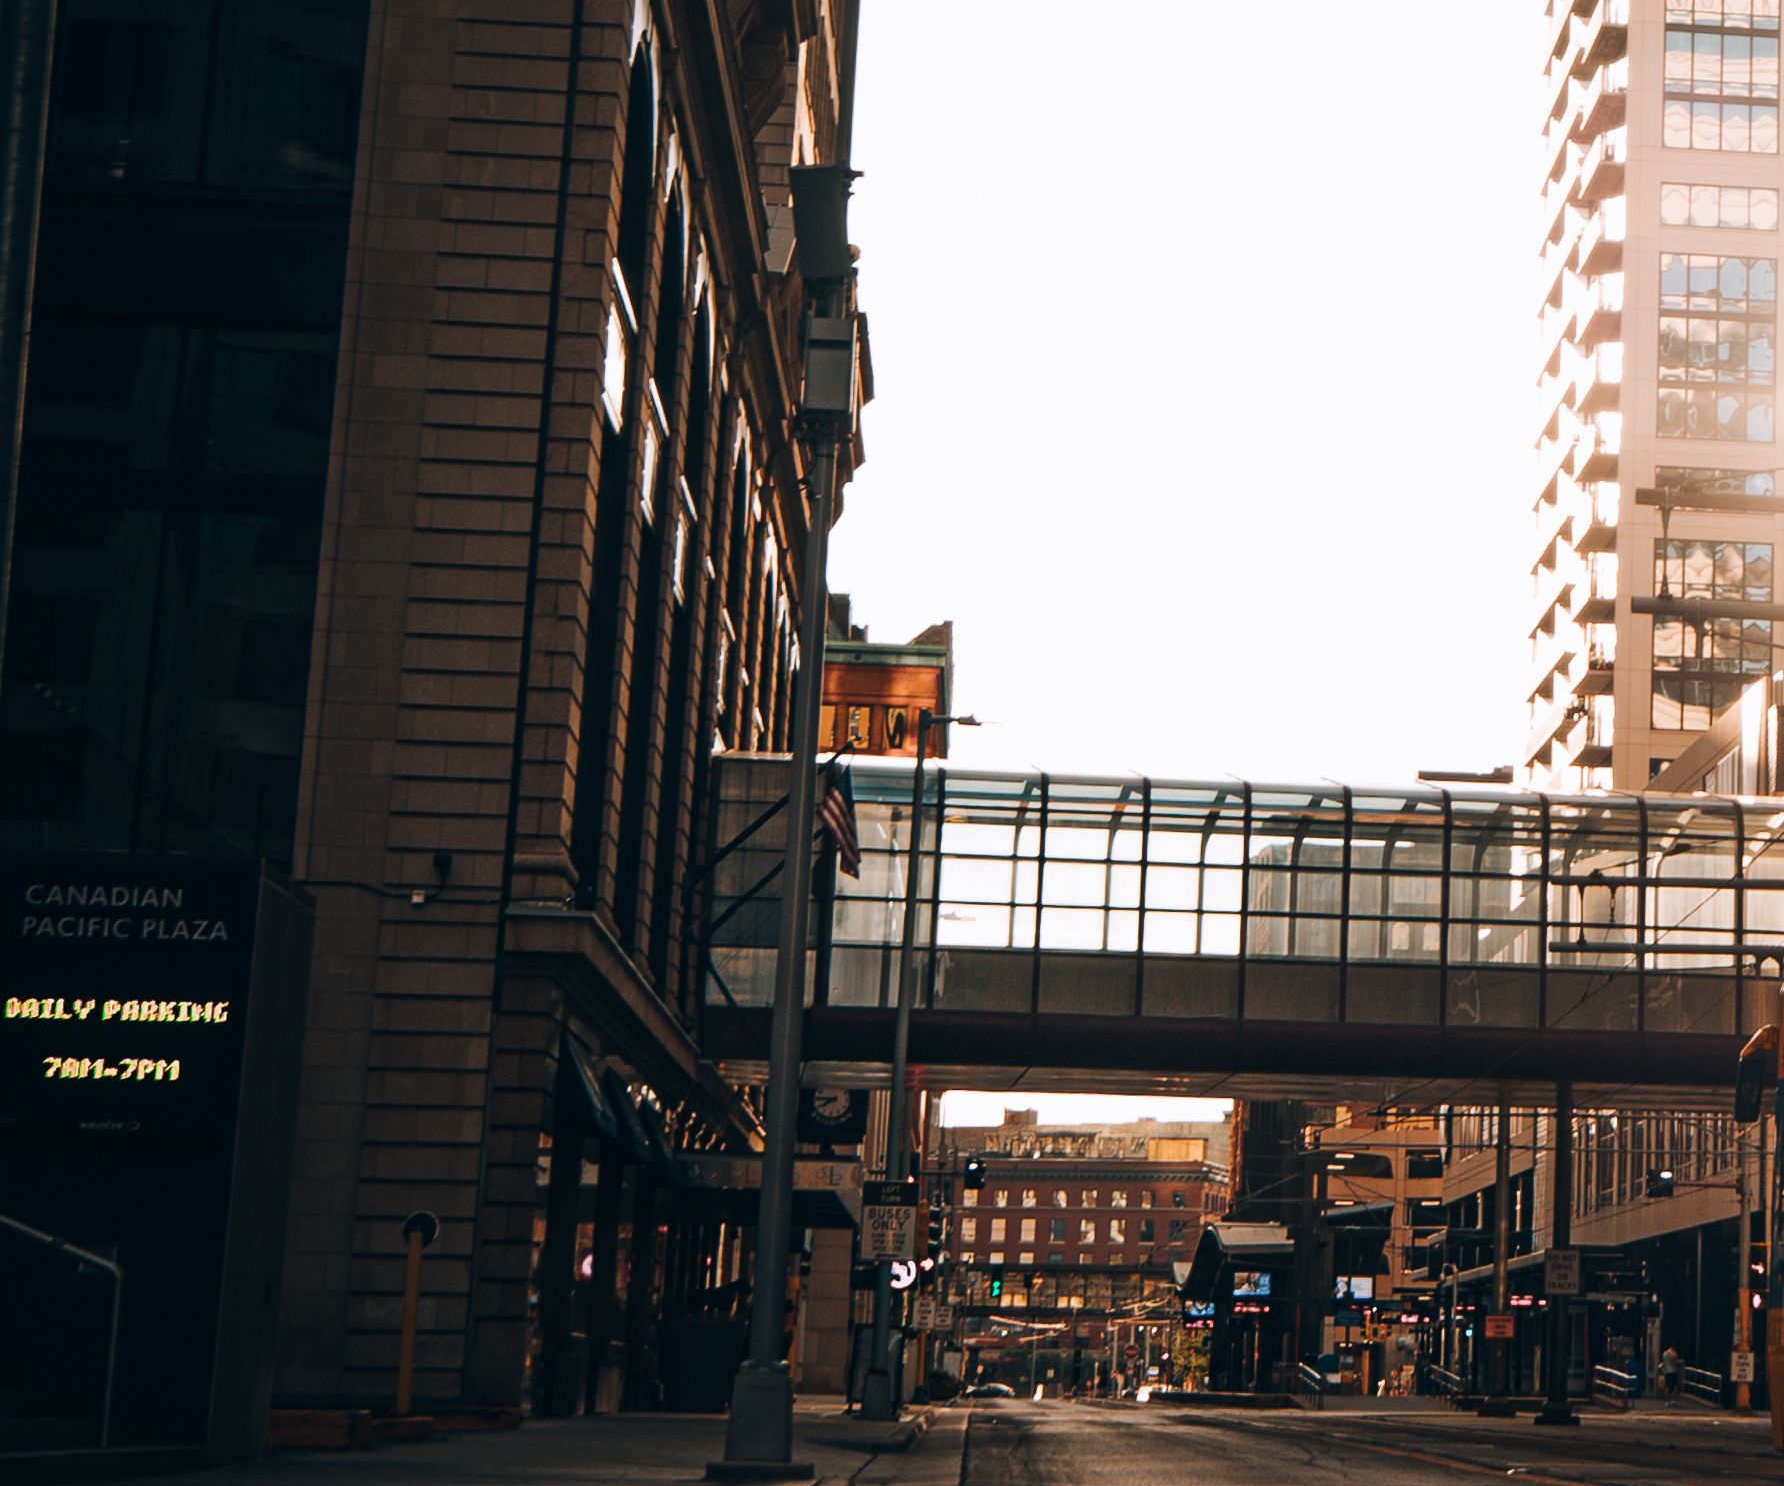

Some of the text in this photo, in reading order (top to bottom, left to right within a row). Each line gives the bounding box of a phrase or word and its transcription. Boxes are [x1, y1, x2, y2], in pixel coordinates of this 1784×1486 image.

[26, 884, 183, 908] CANADIAN
[22, 915, 229, 941] PACIFIC PLAZA
[5, 996, 231, 1023] DAILY PARKING
[42, 1056, 181, 1081] 7AM-7PM
[869, 1208, 911, 1219] BUSES
[872, 1218, 906, 1230] ONLY
